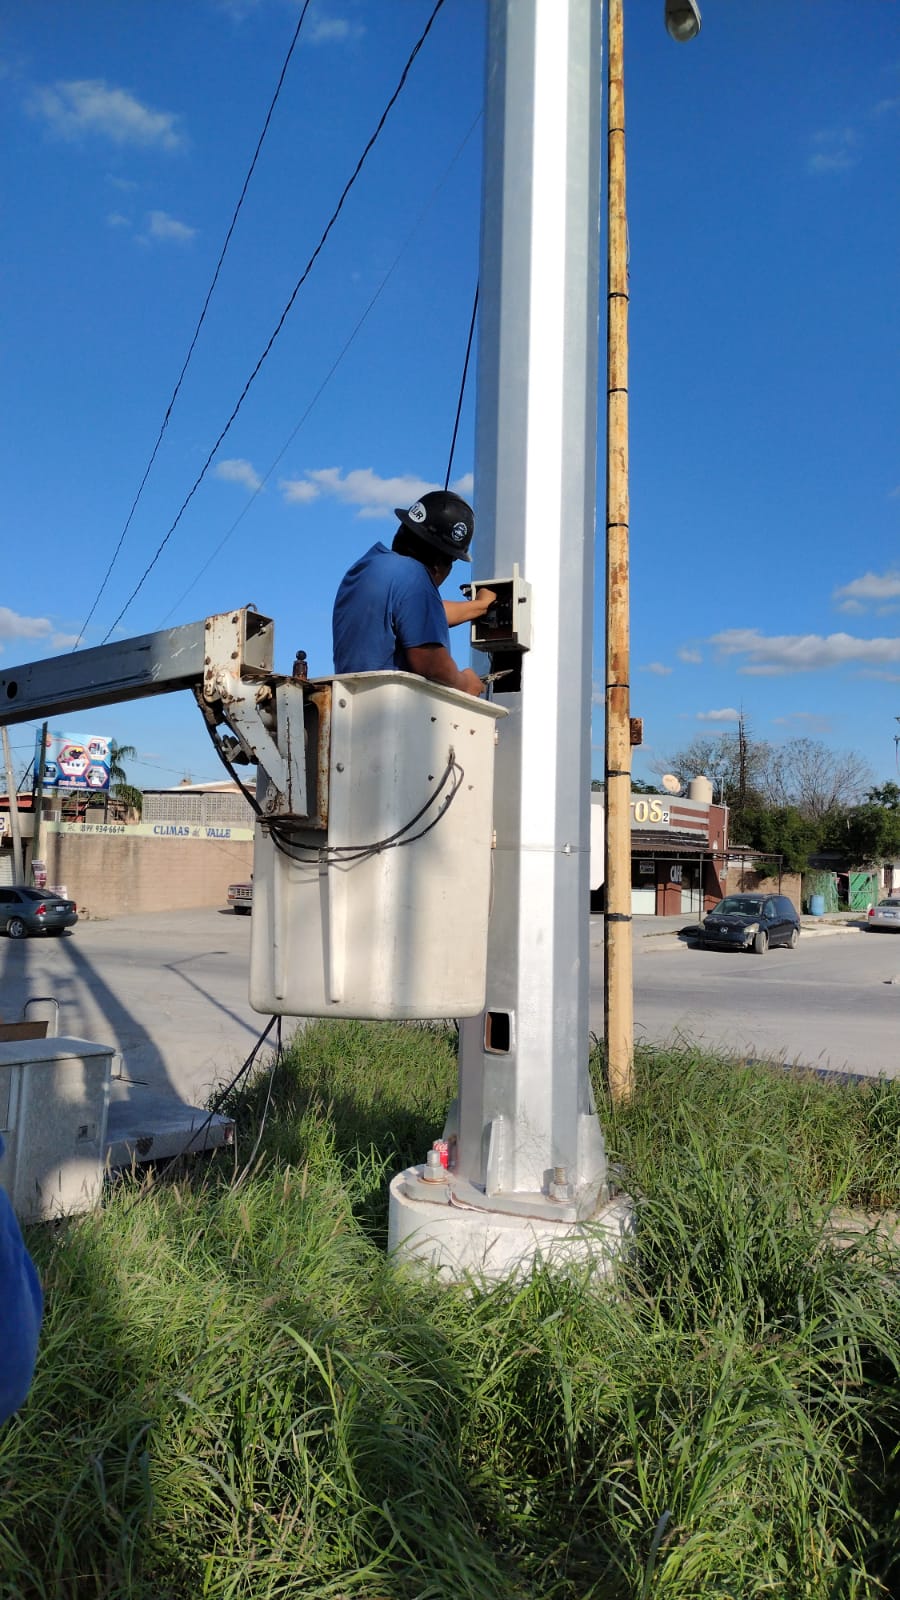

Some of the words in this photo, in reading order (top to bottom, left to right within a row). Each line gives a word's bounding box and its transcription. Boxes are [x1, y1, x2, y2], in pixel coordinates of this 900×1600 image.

[629, 798, 663, 823] O'S
[663, 812, 669, 822] 2
[153, 825, 190, 836] CLIMAS
[205, 827, 231, 838] VALLE
